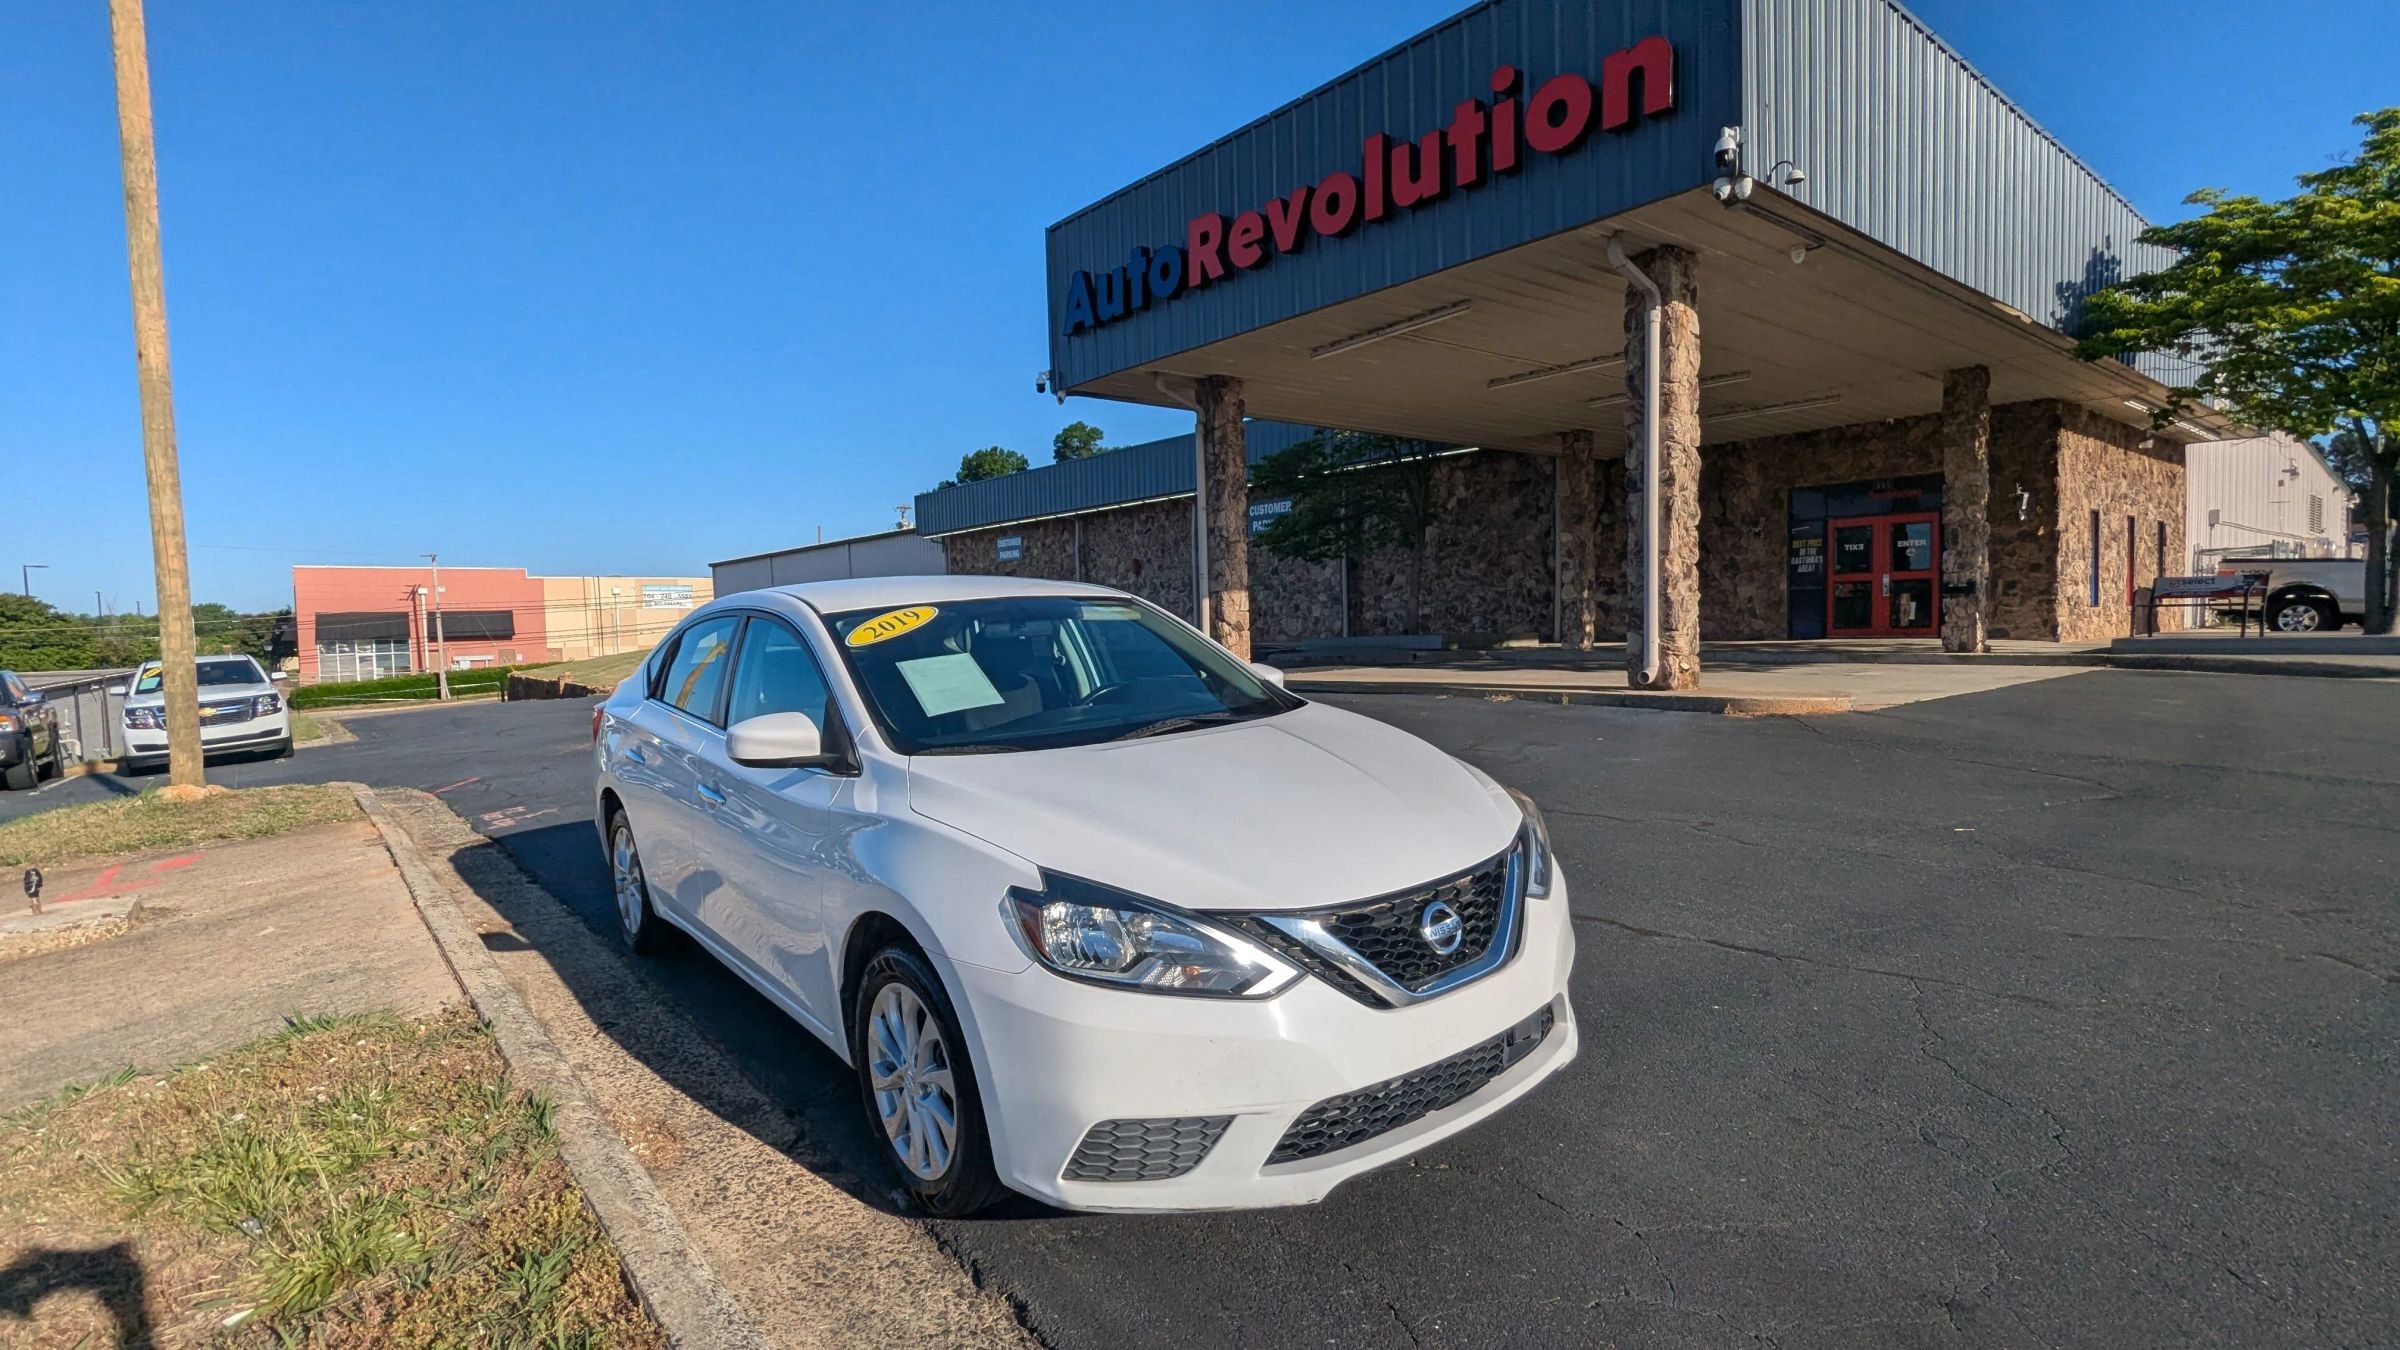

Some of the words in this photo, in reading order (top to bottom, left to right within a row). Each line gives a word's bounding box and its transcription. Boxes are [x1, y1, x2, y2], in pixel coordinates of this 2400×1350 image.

[1250, 501, 1292, 517] CUSTOMER
[1897, 540, 1927, 548] ENTER
[863, 611, 920, 639] 2019
[1430, 918, 1459, 938] NISSAN
